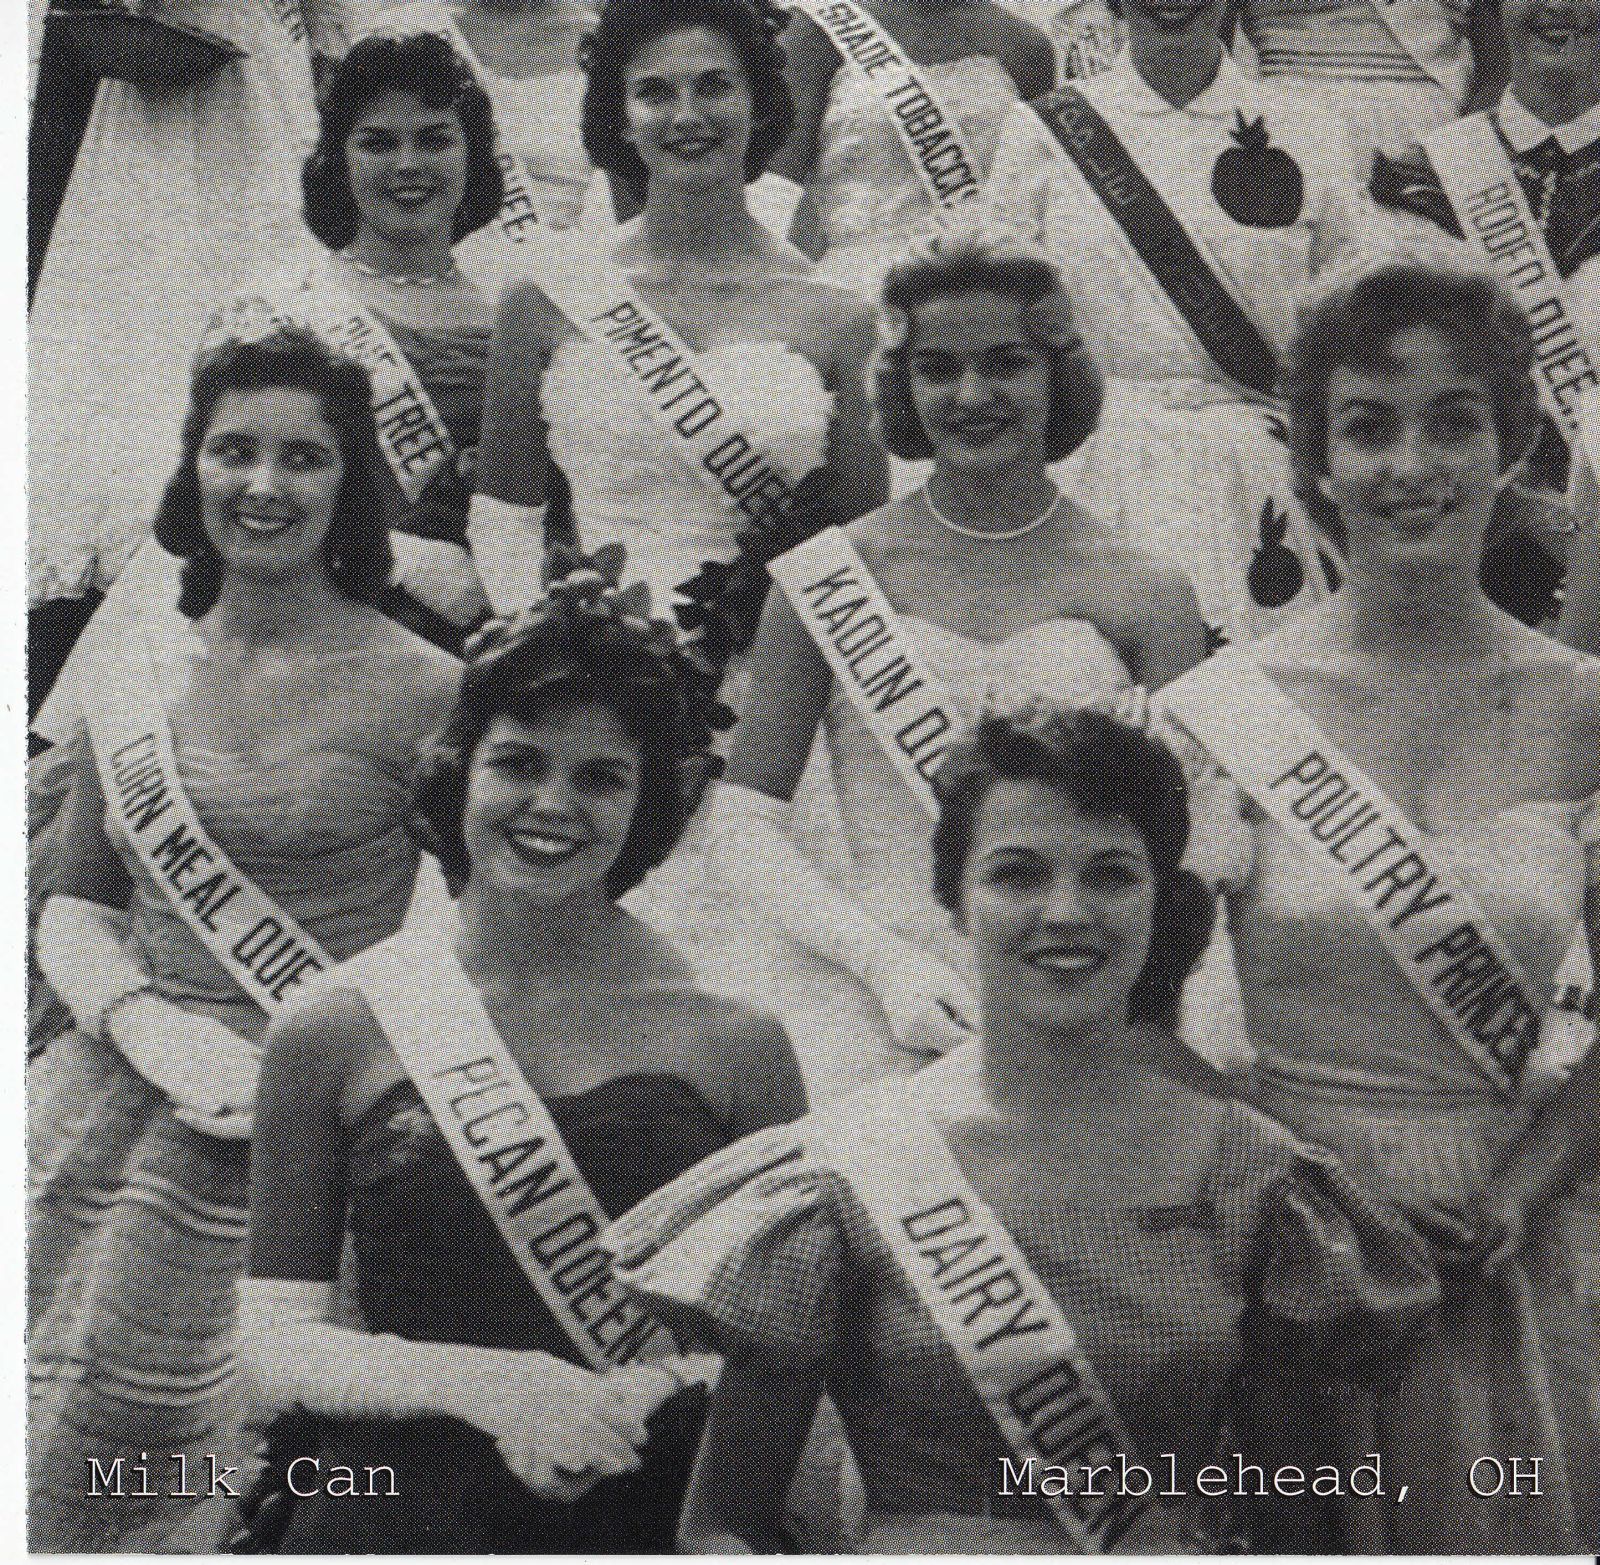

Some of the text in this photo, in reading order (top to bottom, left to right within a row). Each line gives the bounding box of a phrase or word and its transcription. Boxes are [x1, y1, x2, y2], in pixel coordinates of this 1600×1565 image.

[817, 3, 903, 80] SHADE
[374, 382, 446, 476] TREE
[590, 301, 724, 439] PIMENTO
[803, 565, 925, 713] KAOLIN
[110, 733, 175, 834] CORN
[152, 822, 242, 934] MEAL
[1268, 750, 1452, 930] POULTRY
[432, 1055, 662, 1368] PECAN QUEEN
[902, 1196, 1050, 1352] DAIRY
